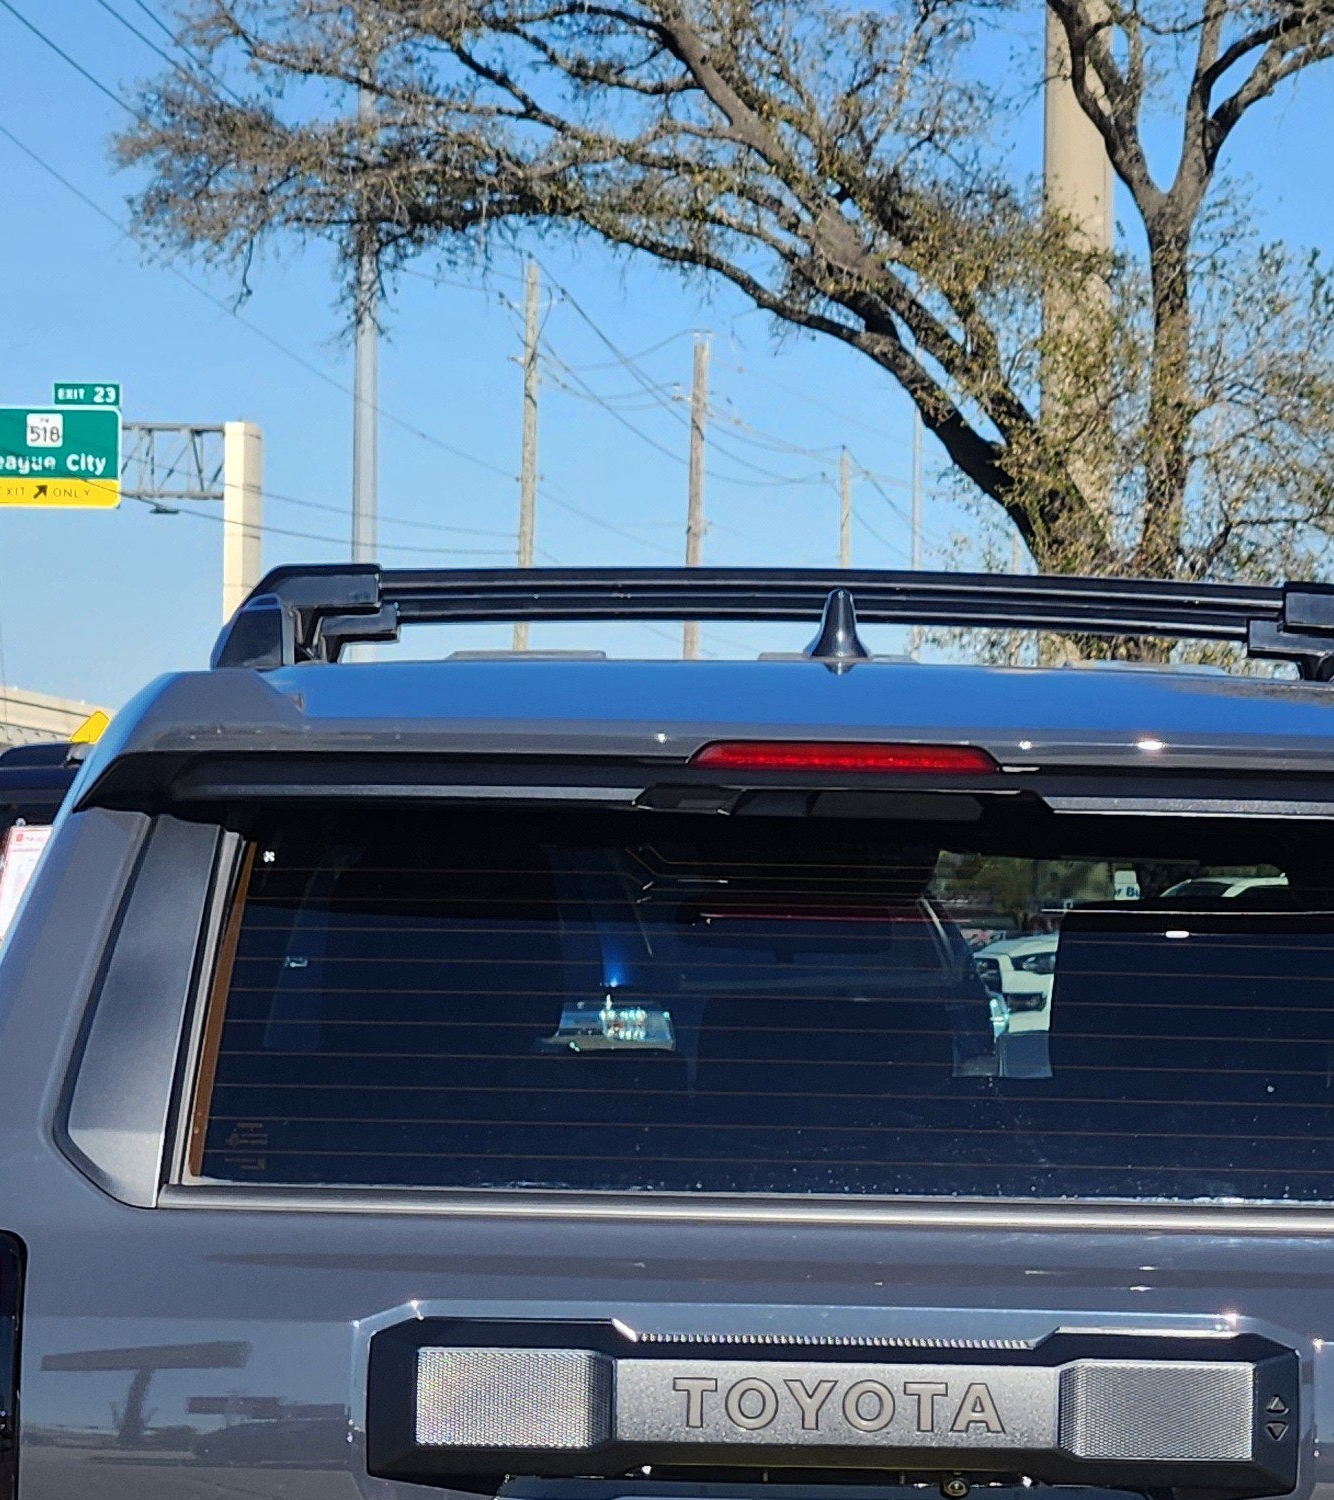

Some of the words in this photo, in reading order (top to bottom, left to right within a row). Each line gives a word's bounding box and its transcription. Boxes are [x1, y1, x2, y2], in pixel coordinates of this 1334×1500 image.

[57, 388, 85, 400] EXIT
[93, 386, 116, 403] 23
[29, 425, 61, 443] 518
[66, 452, 107, 475] City
[53, 487, 91, 498] ONLY
[672, 1376, 1007, 1435] TOYOTA
